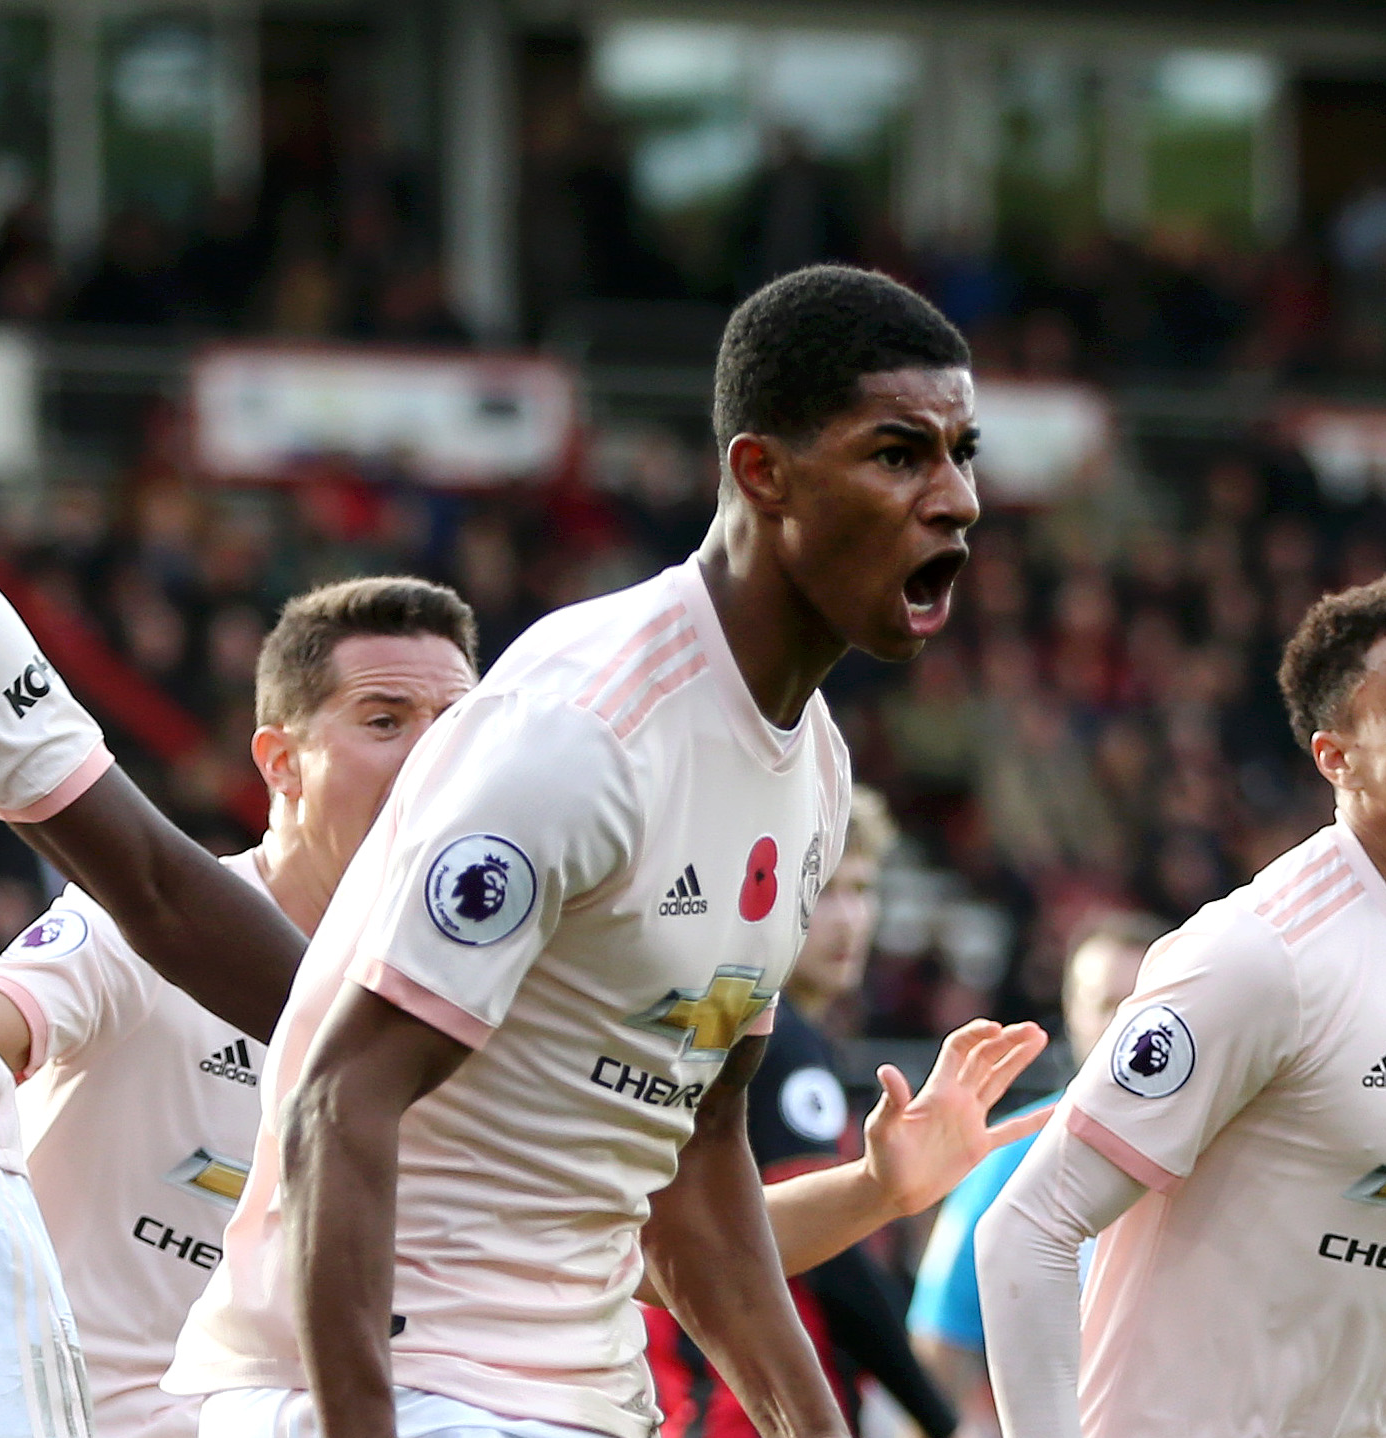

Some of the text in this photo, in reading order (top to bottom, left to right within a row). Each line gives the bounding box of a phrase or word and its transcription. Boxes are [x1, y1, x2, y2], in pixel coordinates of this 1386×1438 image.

[658, 896, 708, 917] adidas
[199, 1058, 258, 1088] adidas
[590, 1055, 705, 1109] CHEVR
[133, 1214, 224, 1271] CHE
